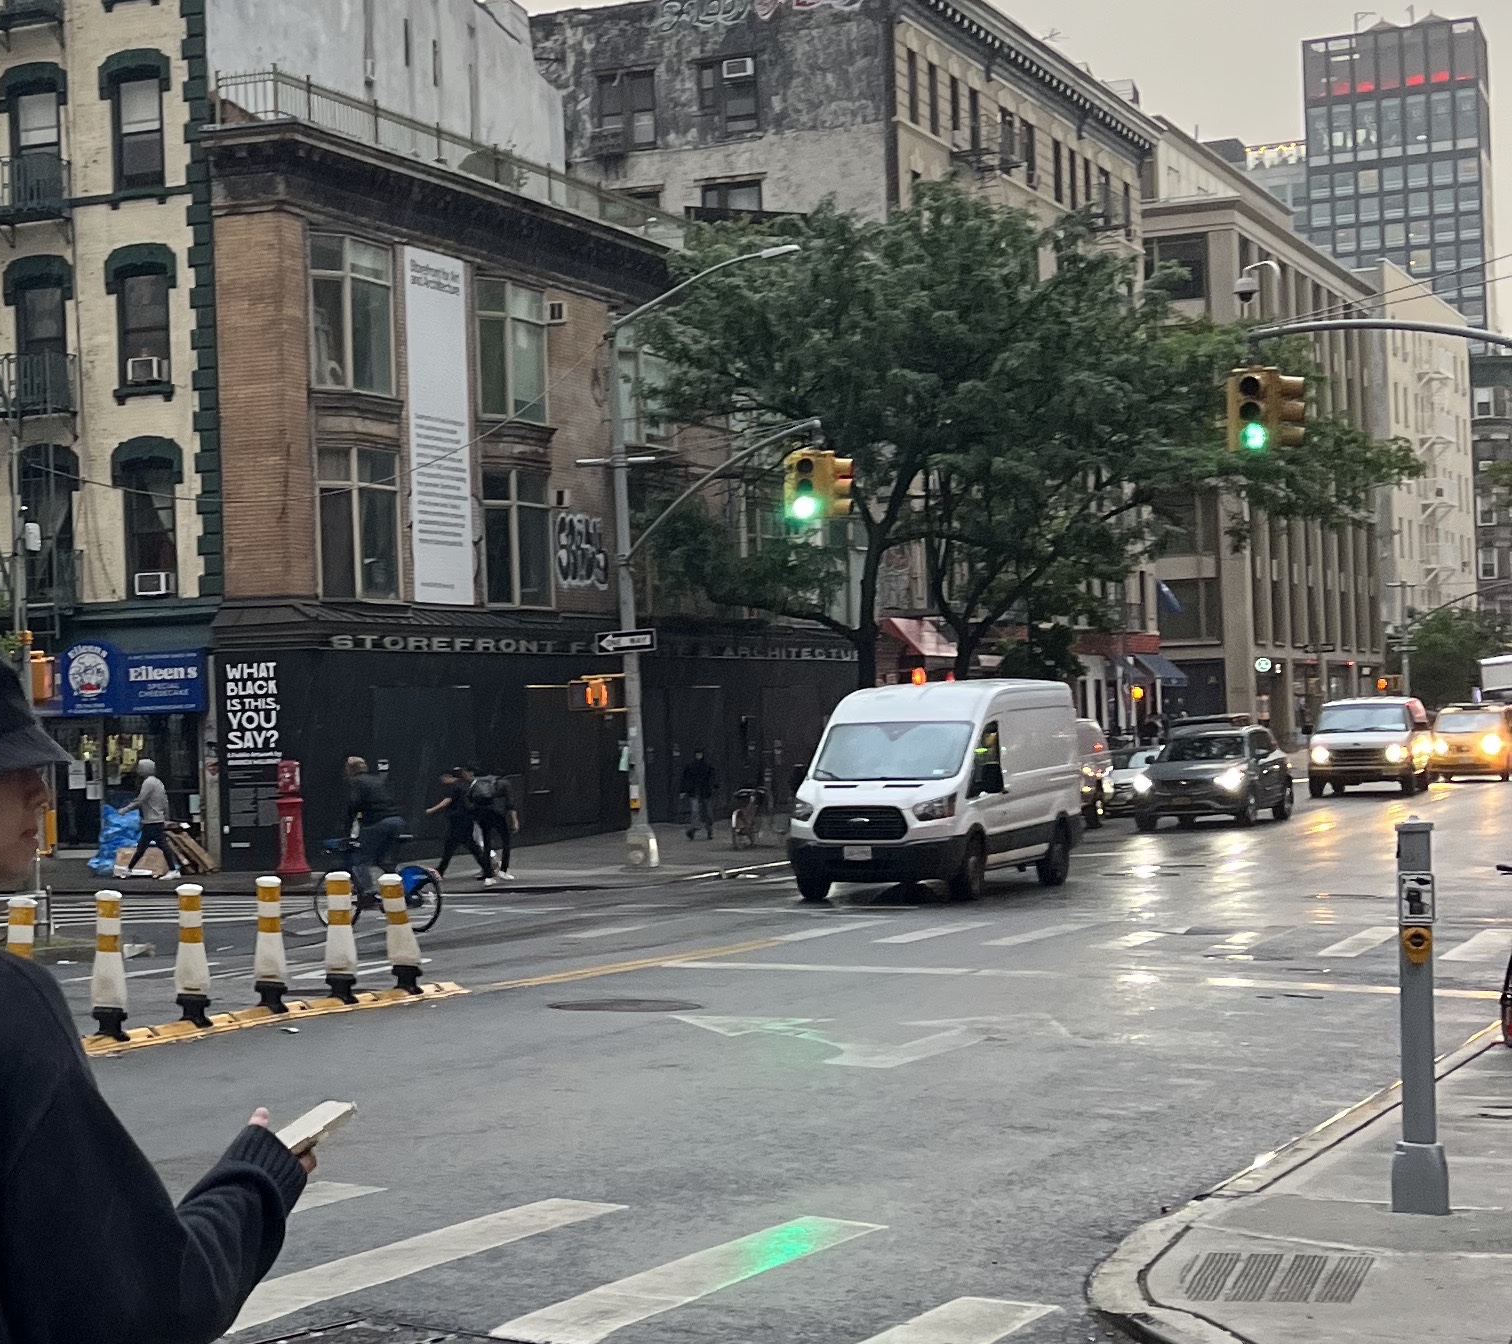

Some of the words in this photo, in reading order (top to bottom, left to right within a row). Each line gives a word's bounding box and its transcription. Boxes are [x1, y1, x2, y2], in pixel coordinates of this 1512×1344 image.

[330, 635, 557, 654] STOREFRONT
[226, 662, 276, 679] WHAT
[226, 680, 278, 696] BLACK
[226, 698, 242, 710] IS
[243, 697, 281, 711] THIS,
[226, 710, 277, 730] YOU
[226, 730, 279, 749] SAY?
